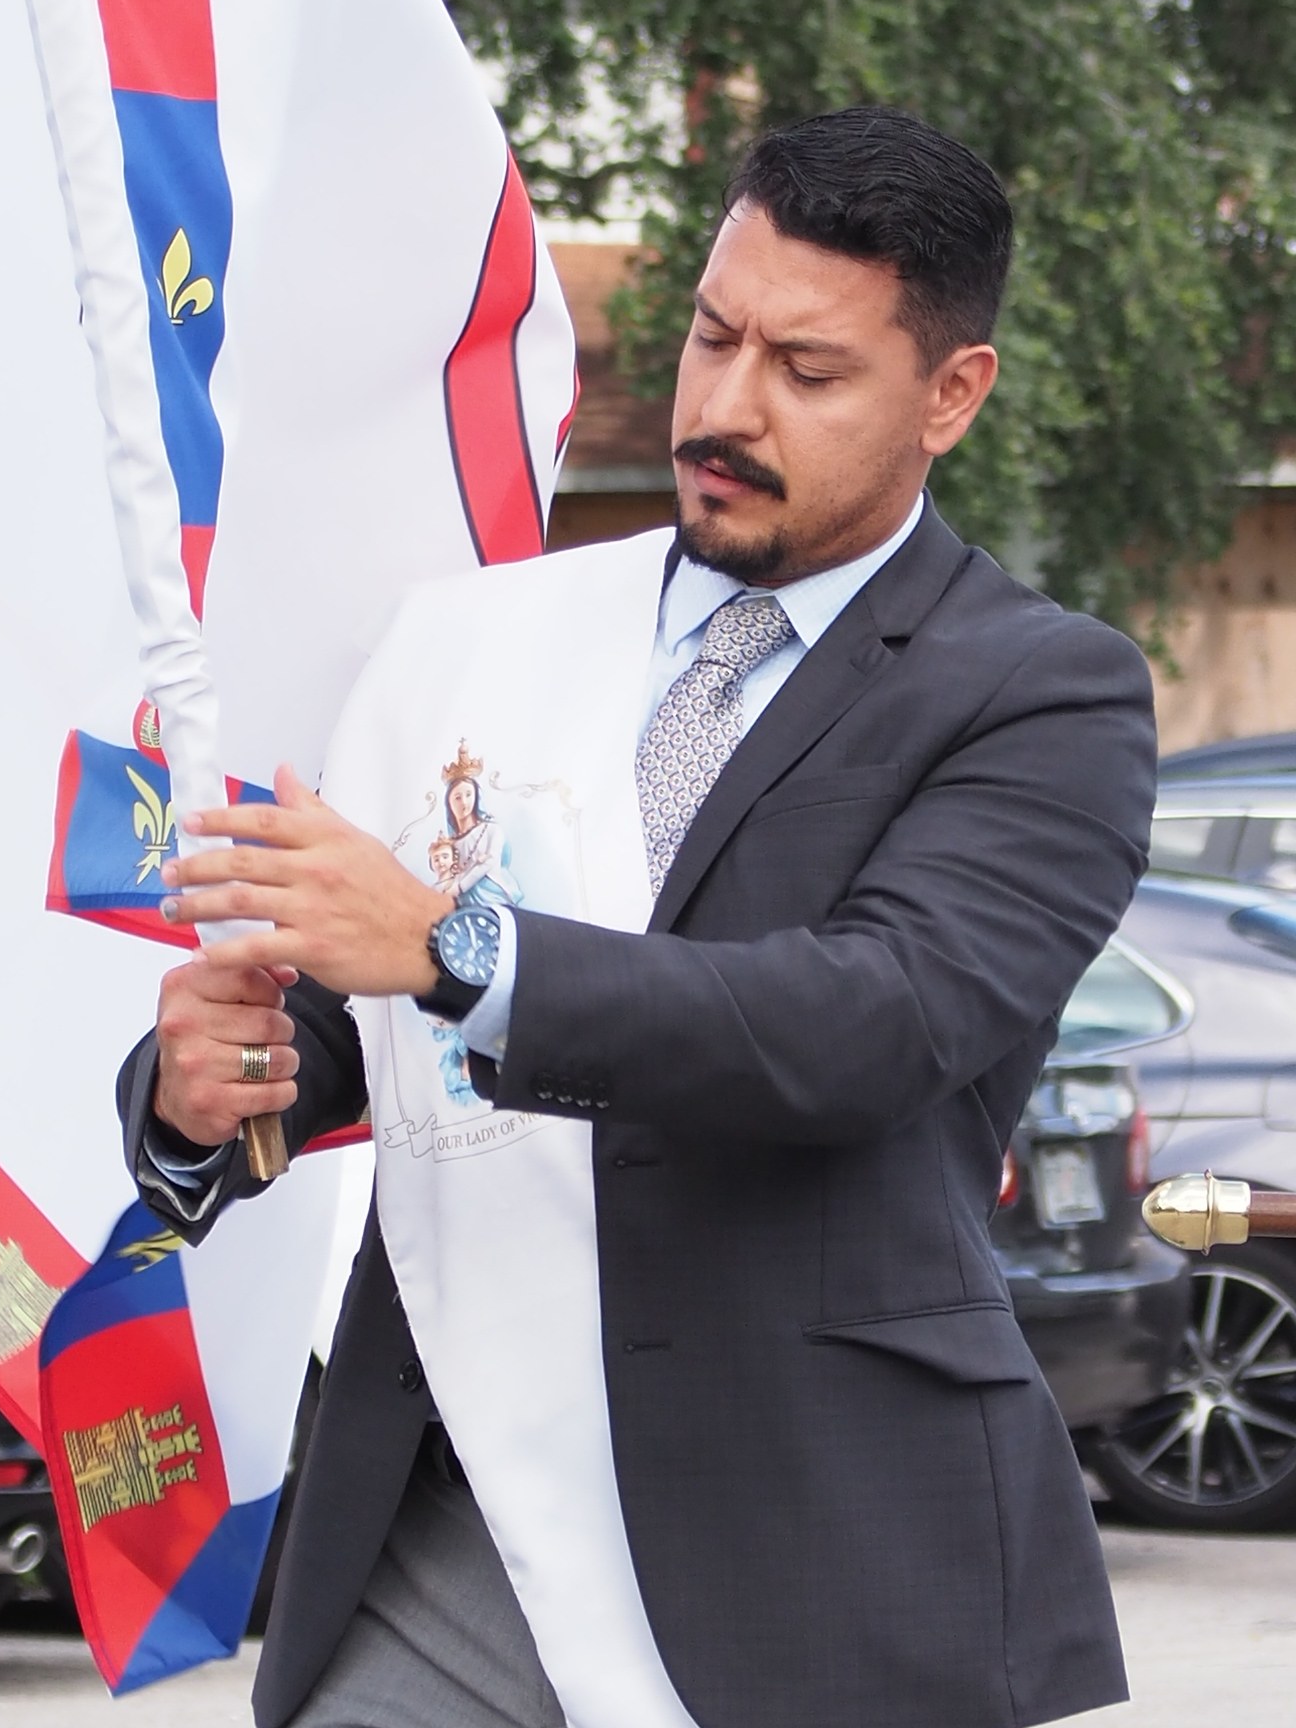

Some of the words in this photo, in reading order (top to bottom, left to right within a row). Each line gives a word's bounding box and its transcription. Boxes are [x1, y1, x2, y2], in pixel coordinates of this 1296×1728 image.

[437, 1136, 462, 1151] OUR
[466, 1125, 498, 1145] LADY
[500, 1118, 517, 1135] OF
